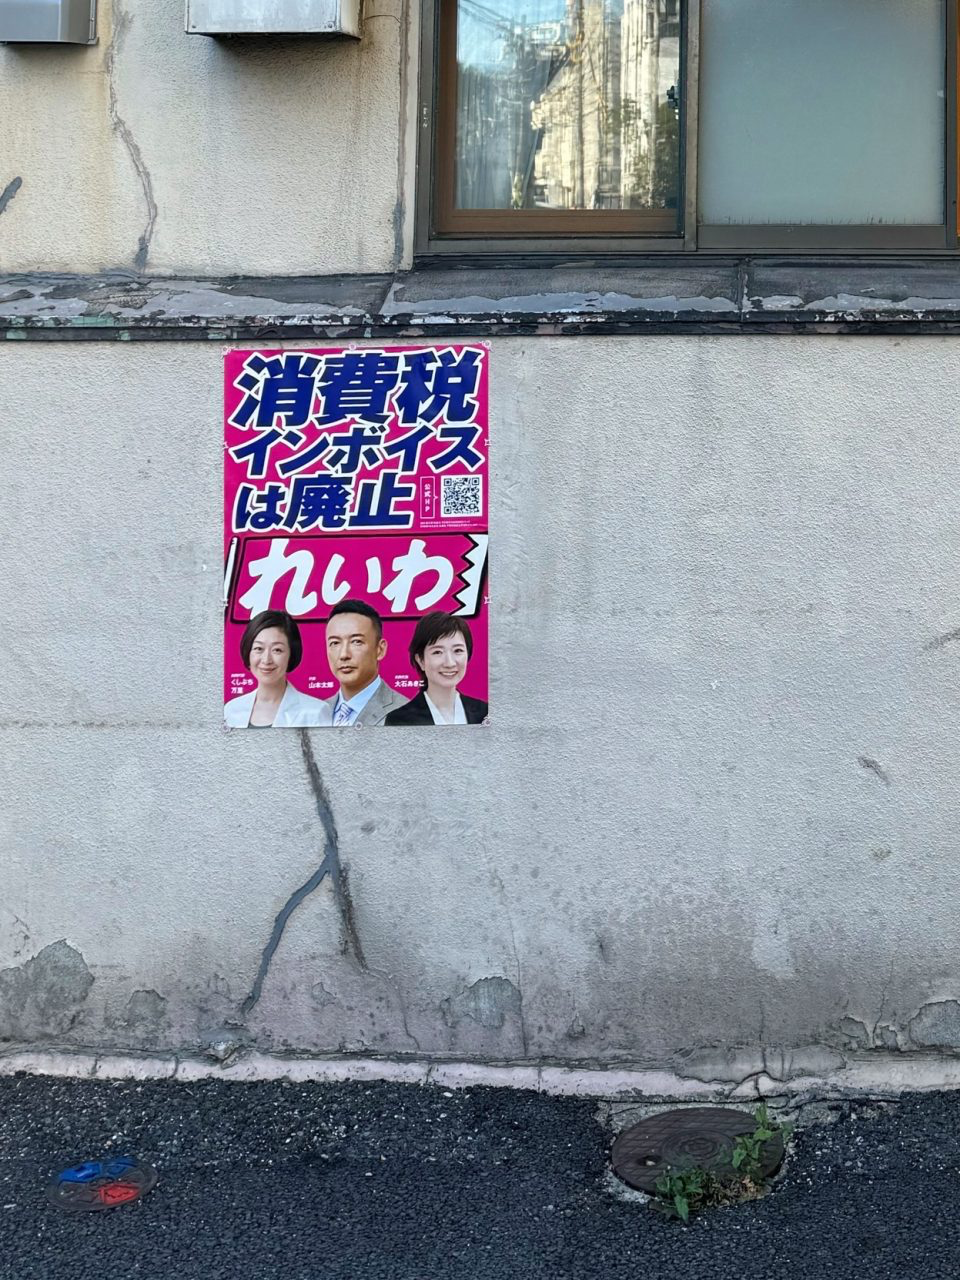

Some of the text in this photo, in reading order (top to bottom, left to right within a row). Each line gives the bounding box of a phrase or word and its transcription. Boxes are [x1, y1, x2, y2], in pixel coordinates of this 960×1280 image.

[232, 350, 480, 429] 消費税
[232, 423, 483, 476] インボイス
[234, 472, 415, 530] は廃止
[239, 538, 453, 620] れいわ
